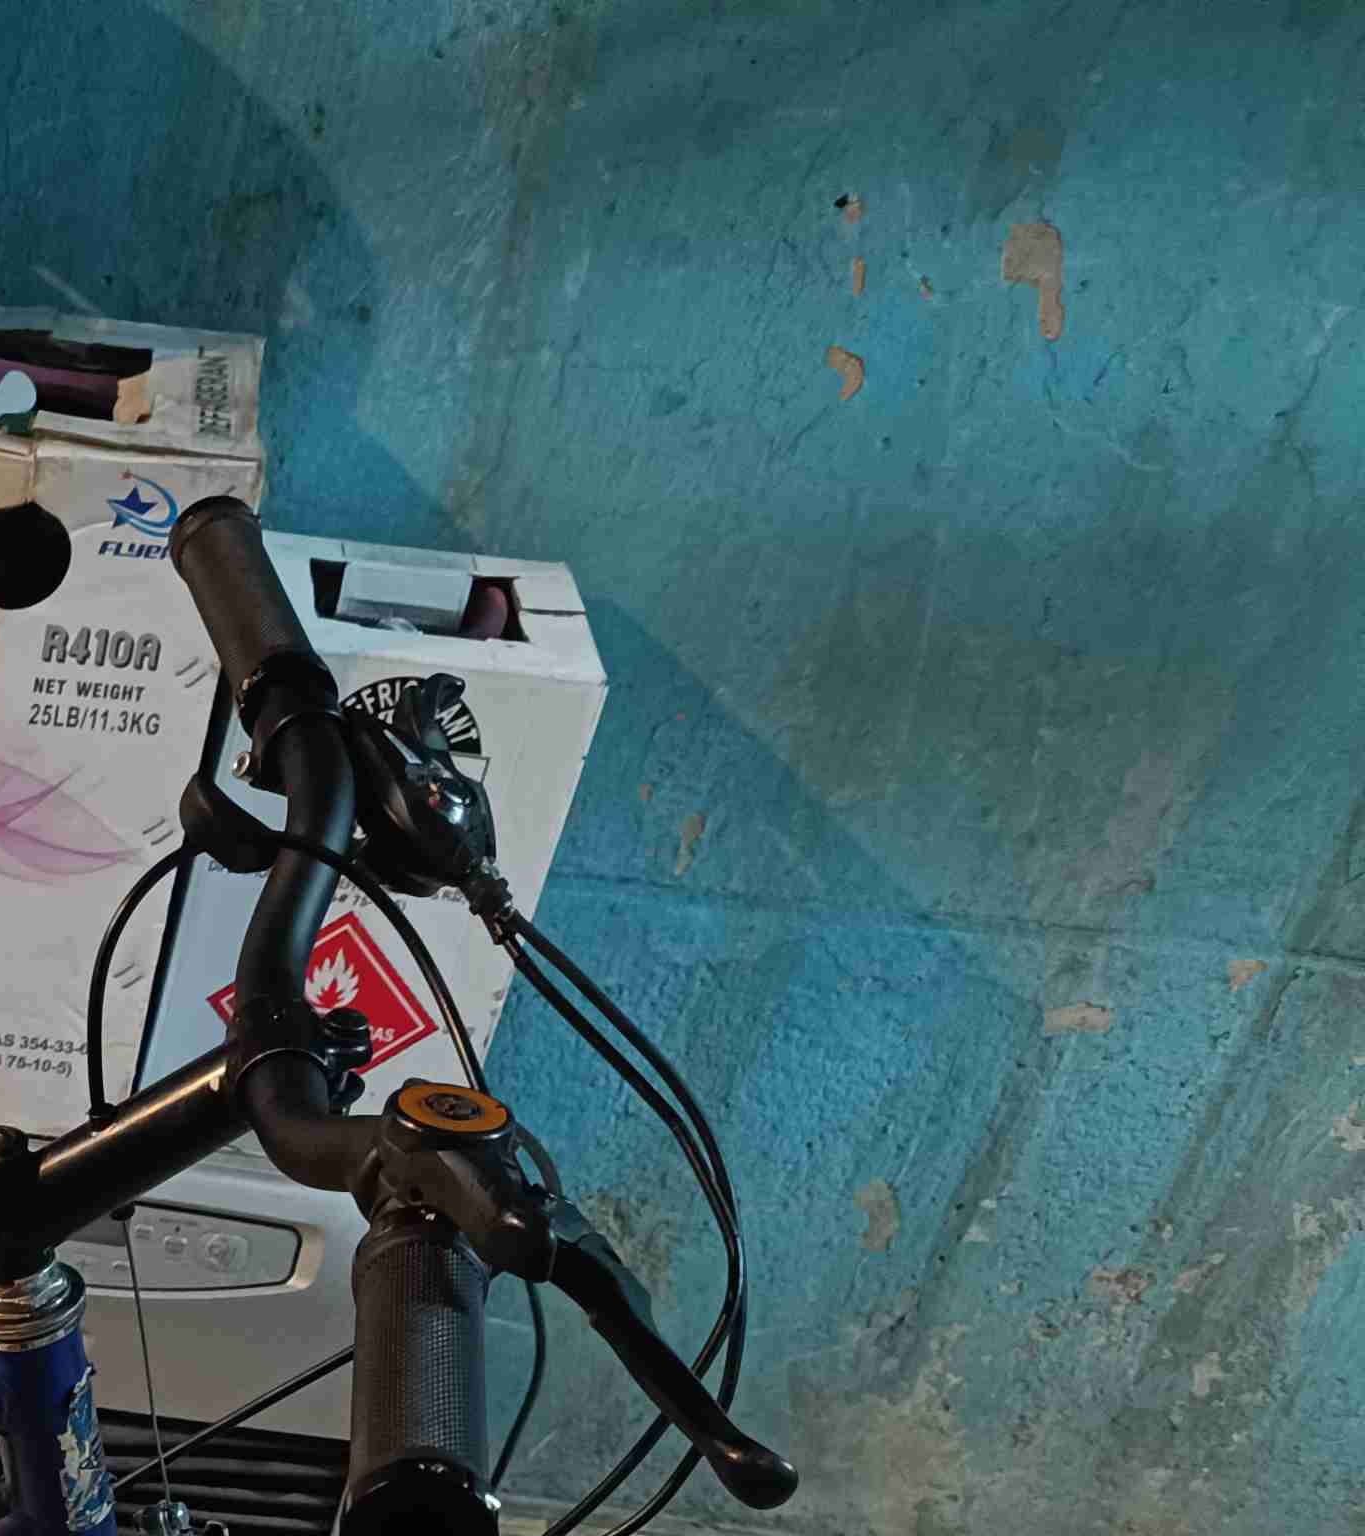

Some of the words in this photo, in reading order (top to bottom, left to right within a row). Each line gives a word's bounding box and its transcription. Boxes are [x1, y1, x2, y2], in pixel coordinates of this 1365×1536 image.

[41, 623, 162, 672] R410A
[33, 676, 67, 696] NET
[76, 680, 146, 702] WEIGHT
[28, 703, 161, 736] 25LB/11.3KG
